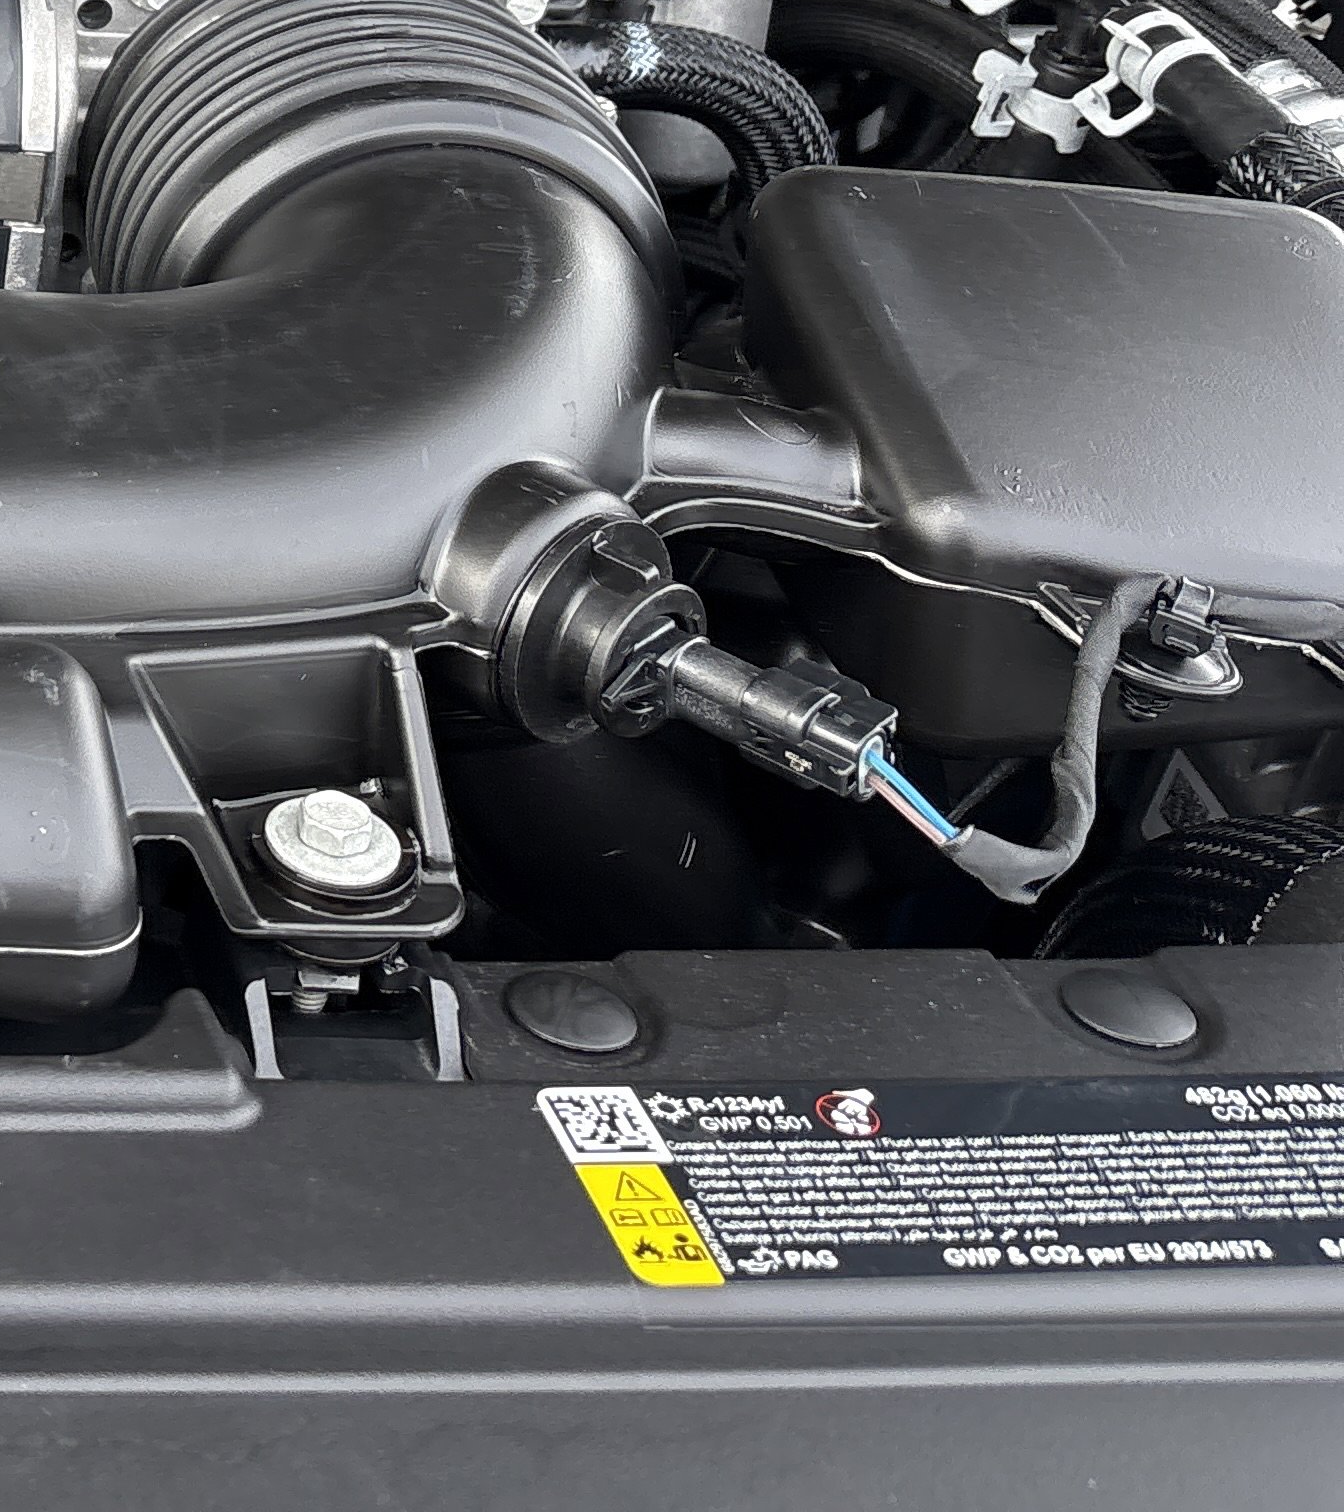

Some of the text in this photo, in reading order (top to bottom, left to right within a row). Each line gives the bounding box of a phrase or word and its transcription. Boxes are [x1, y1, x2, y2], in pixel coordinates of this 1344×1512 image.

[686, 1095, 786, 1116] R-1234yf
[1212, 1105, 1261, 1122] CO2
[699, 1116, 813, 1133] GWP 0.501
[784, 1249, 839, 1270] PAG
[942, 1246, 1002, 1267] GWP
[1029, 1245, 1085, 1265] CO2
[1086, 1247, 1126, 1268] per
[1127, 1242, 1166, 1263] EU
